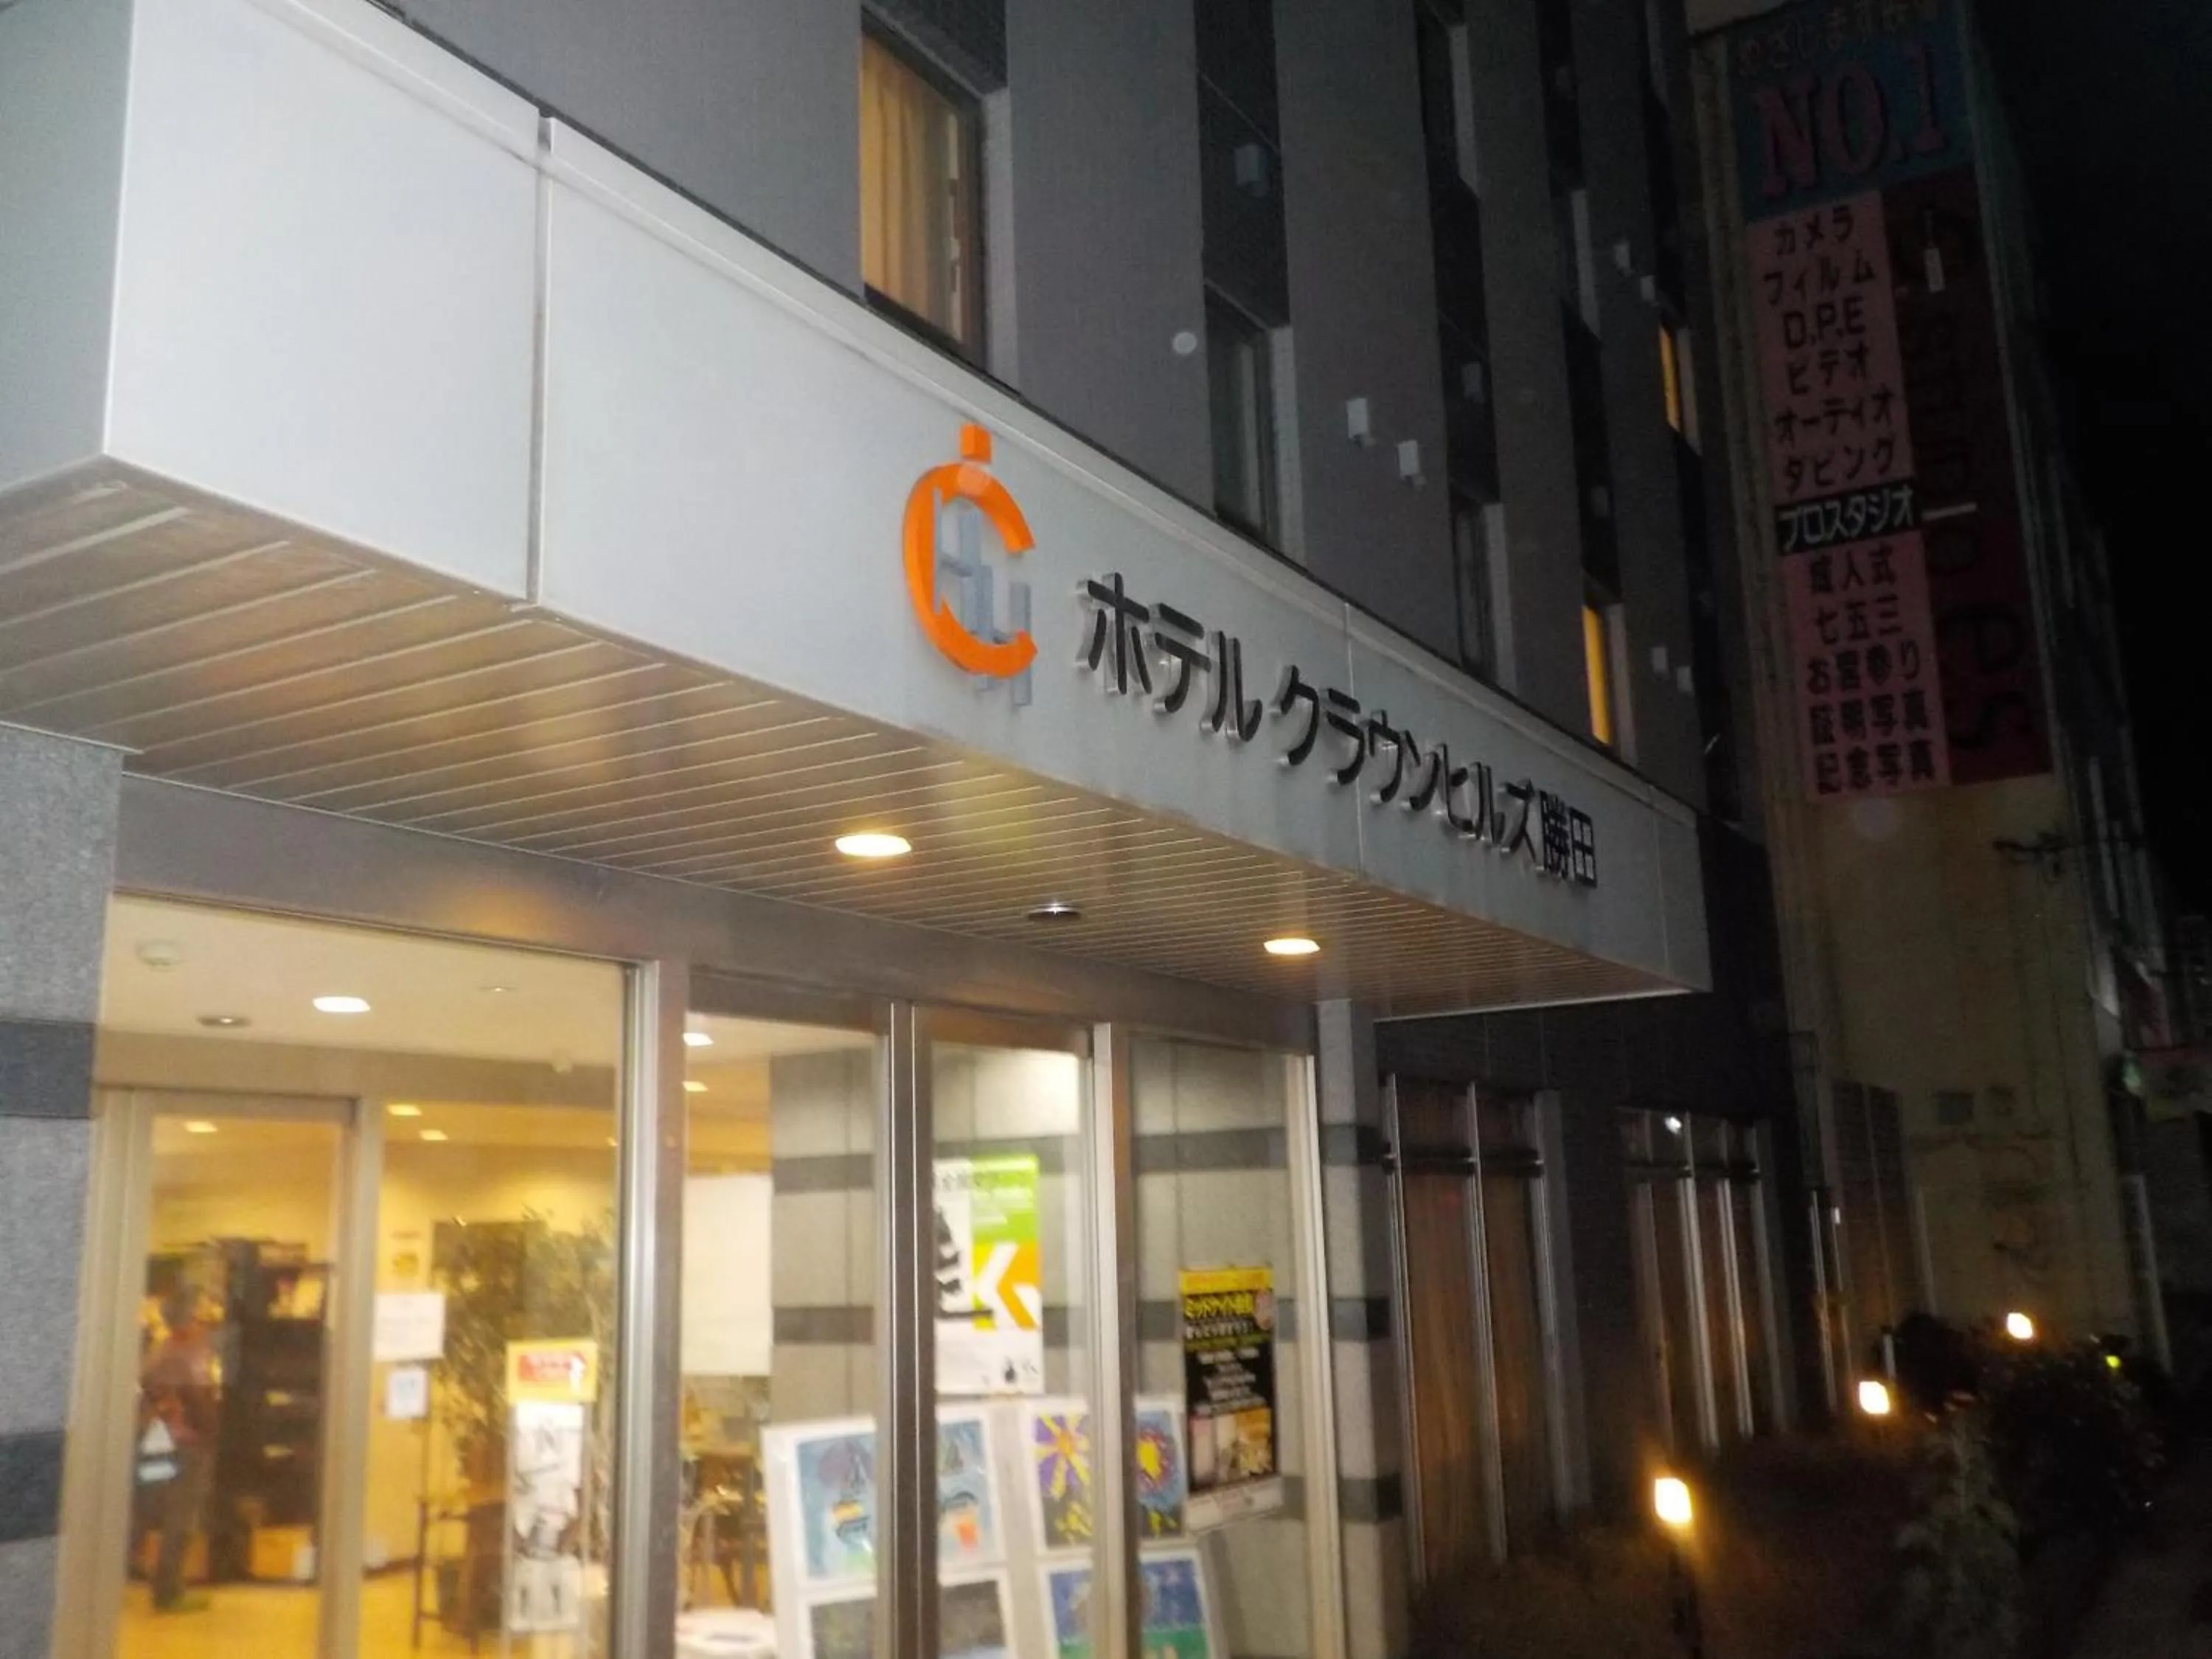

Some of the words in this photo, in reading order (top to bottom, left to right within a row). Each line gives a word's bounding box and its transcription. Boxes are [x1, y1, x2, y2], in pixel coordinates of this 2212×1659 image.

[1773, 204, 1854, 257] カメラ
[1777, 483, 1915, 554] プロスタジオ
[1815, 593, 1902, 646] 七五三
